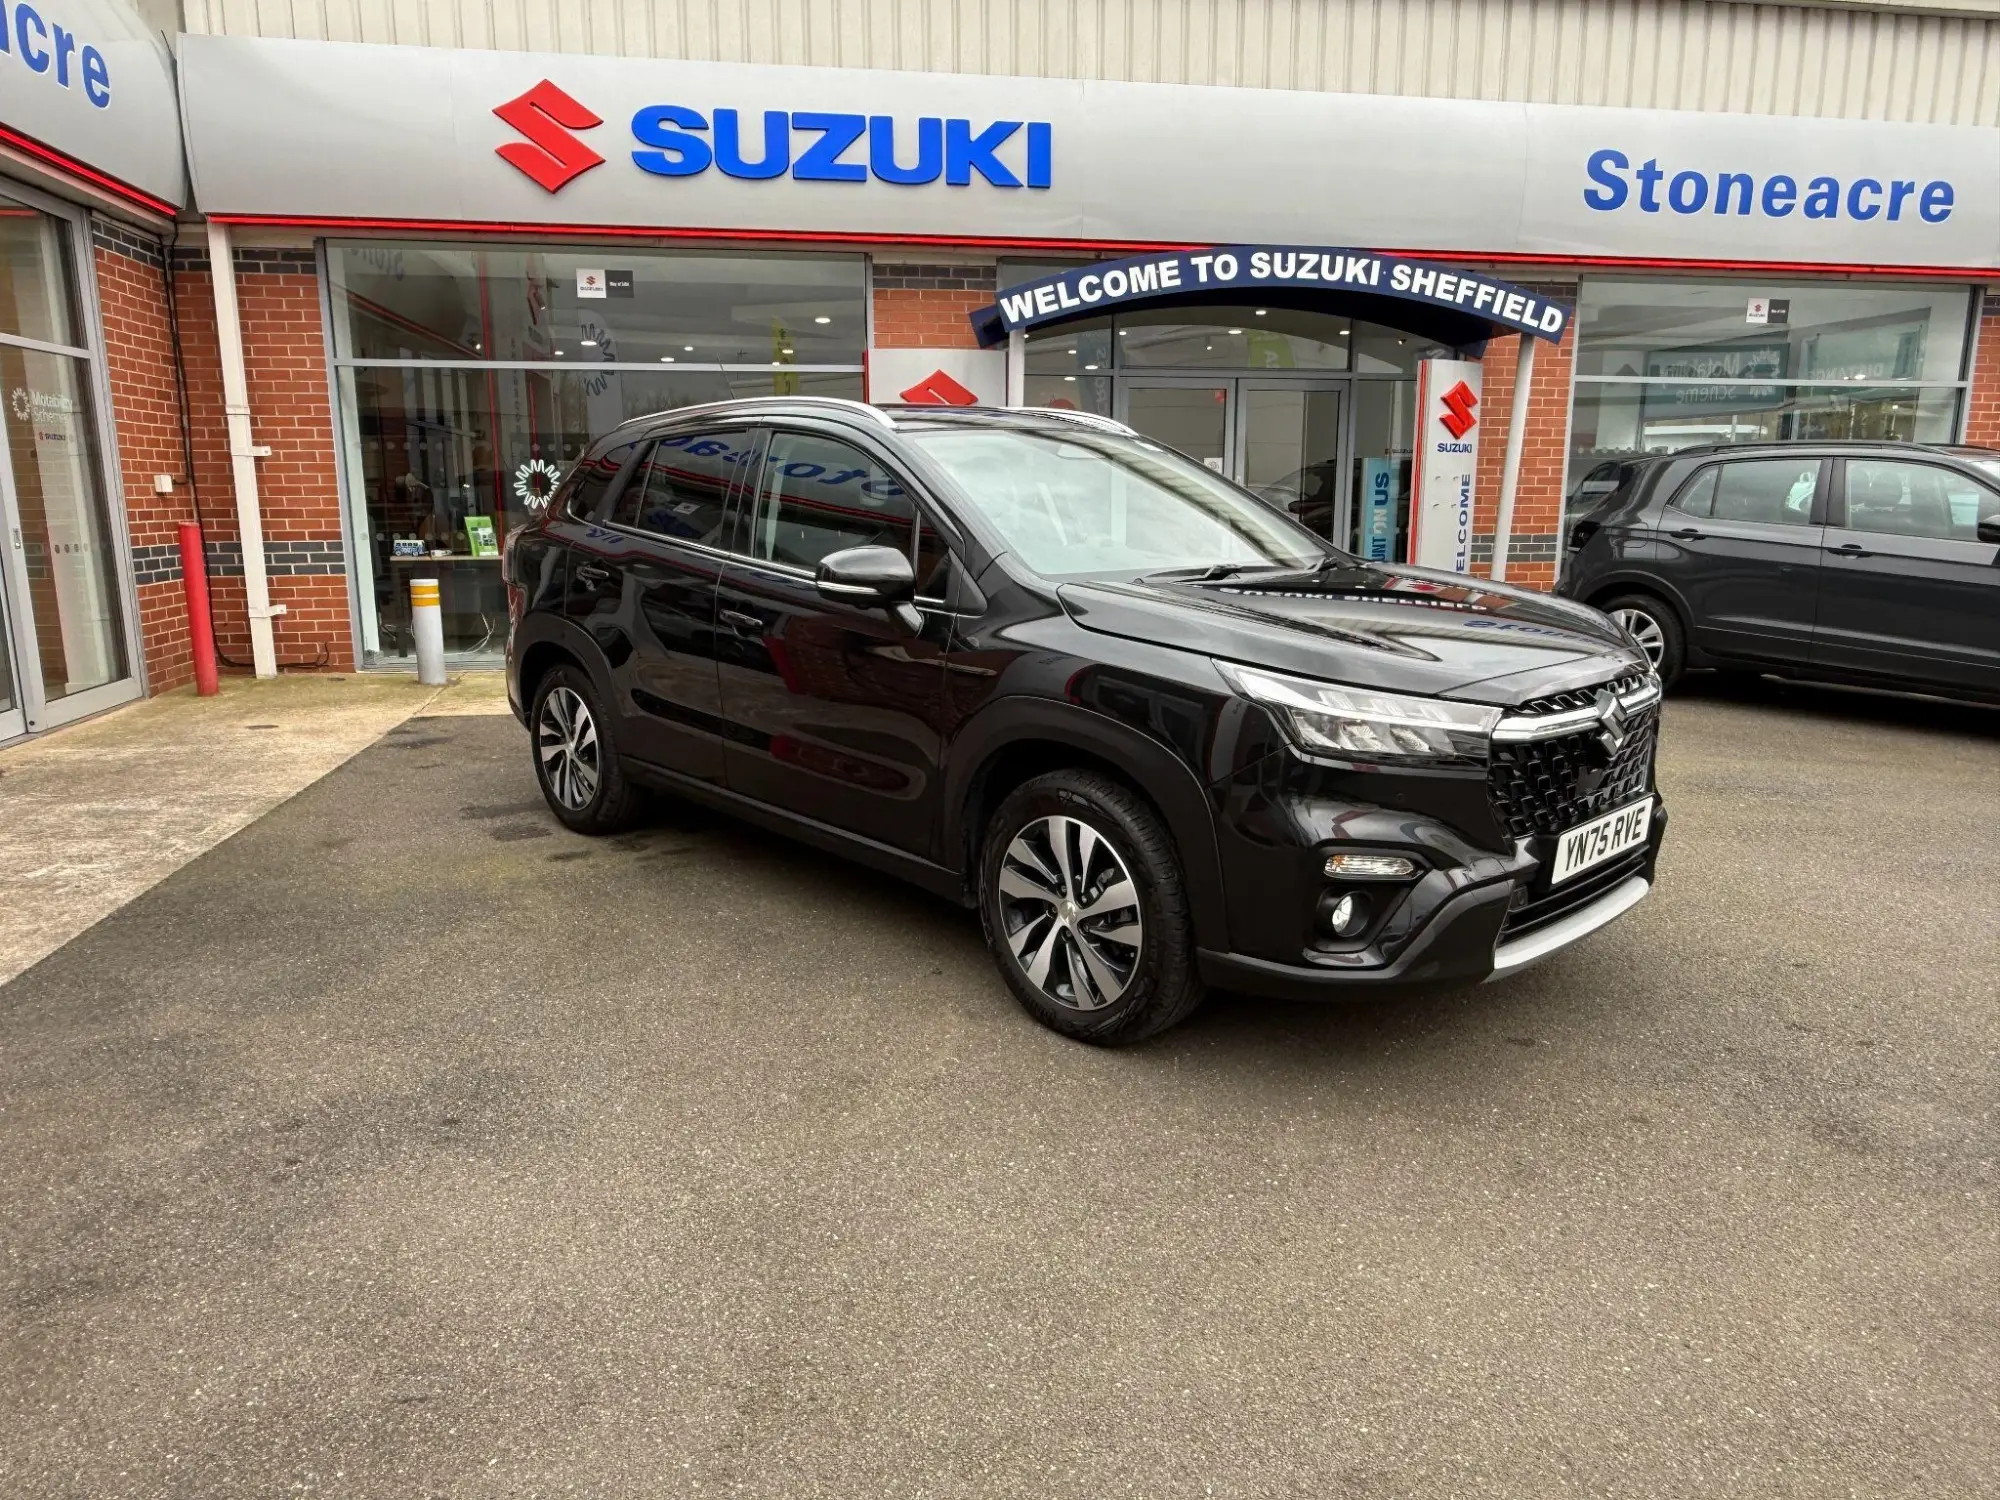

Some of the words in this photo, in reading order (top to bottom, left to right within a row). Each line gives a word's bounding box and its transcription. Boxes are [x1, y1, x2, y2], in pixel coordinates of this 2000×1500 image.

[631, 105, 1052, 189] SUZUKI
[1583, 149, 1955, 224] Stoneacre
[1000, 259, 1182, 324] WELCOME
[1191, 254, 1239, 283] TO
[1249, 252, 1381, 286] SUZUKI
[1390, 264, 1563, 333] SHEFFIELD
[1437, 442, 1473, 454] SUZUKI
[1374, 472, 1390, 506] US
[1455, 474, 1471, 572] ELCOME
[1371, 536, 1387, 561] UNT
[1565, 821, 1611, 872] YN75
[1611, 806, 1646, 850] RVE
